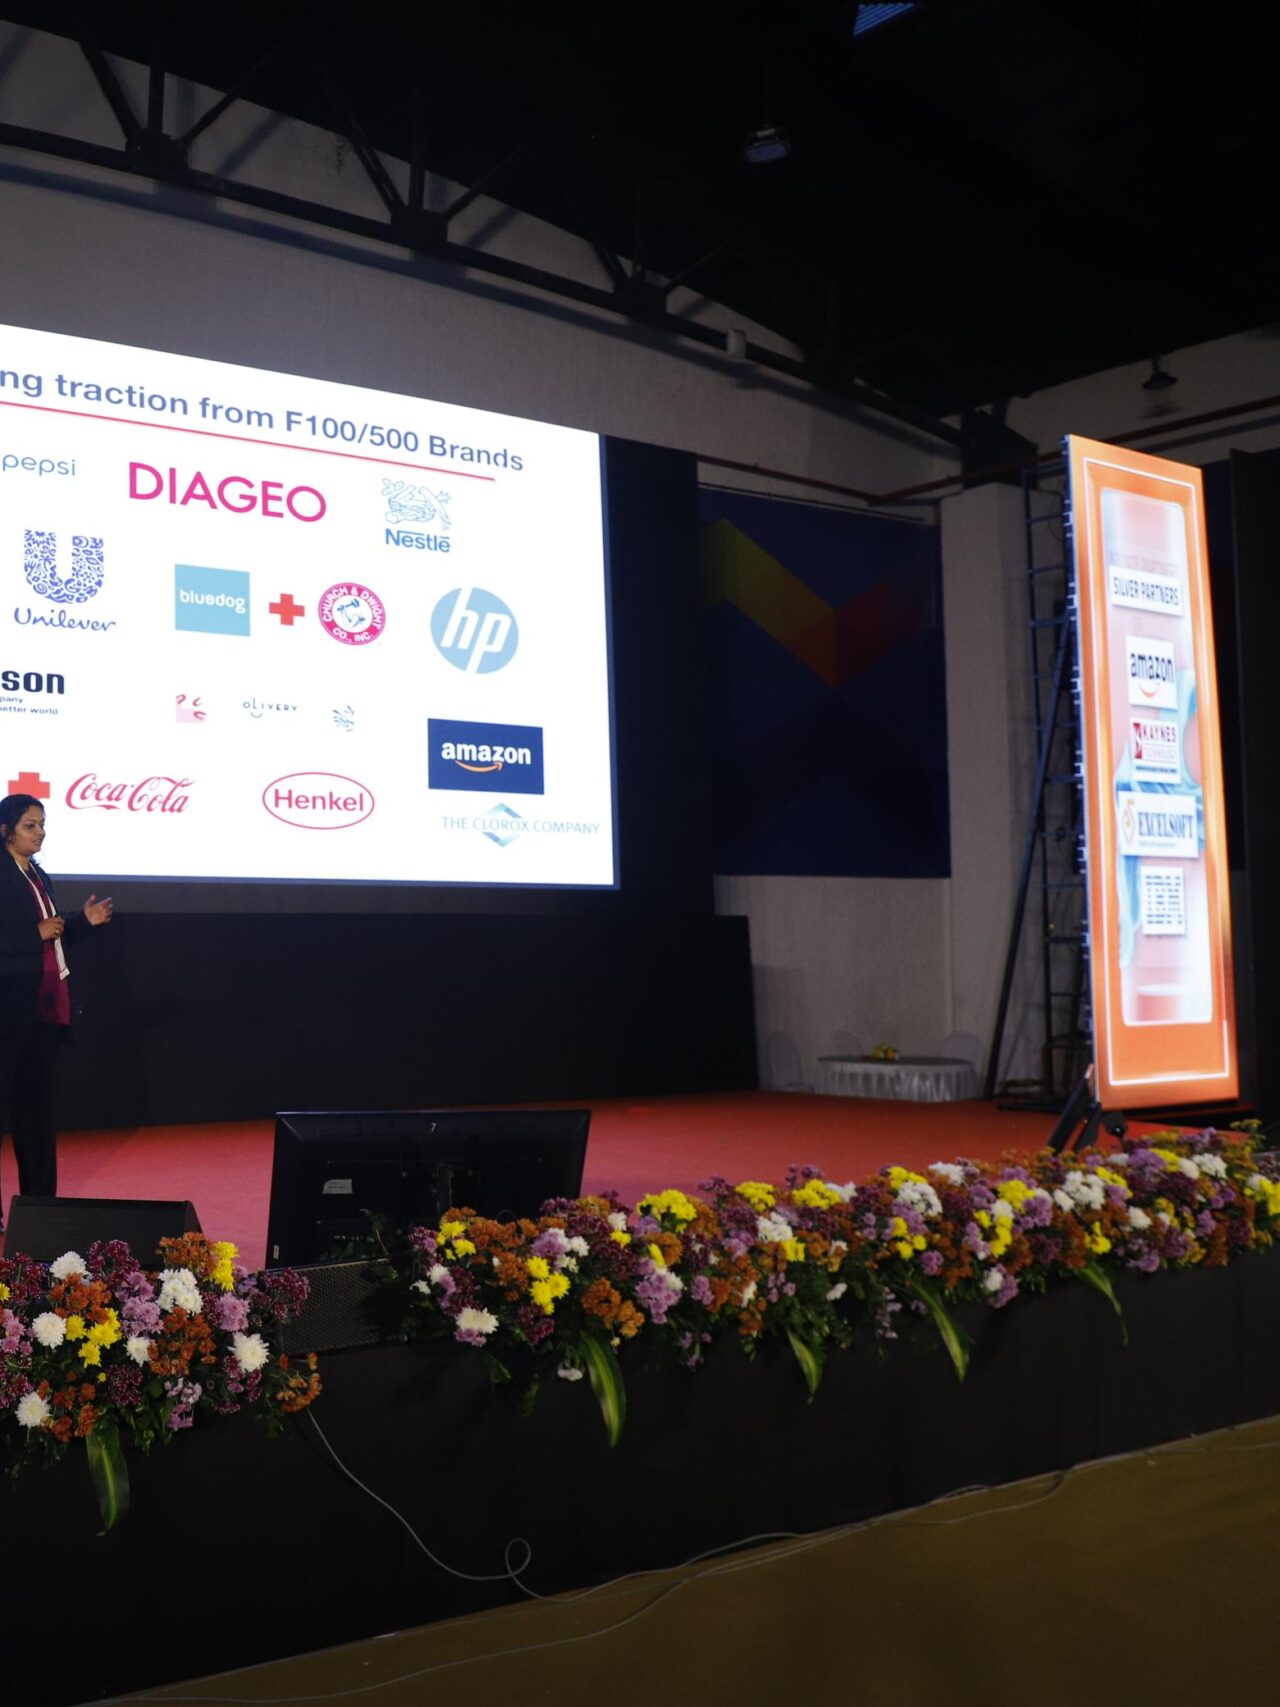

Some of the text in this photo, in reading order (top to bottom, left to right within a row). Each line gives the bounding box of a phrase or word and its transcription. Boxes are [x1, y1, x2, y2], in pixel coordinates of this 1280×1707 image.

[55, 374, 188, 415] traction
[199, 397, 274, 429] from
[286, 410, 419, 452] F100/500
[429, 435, 524, 471] Brands
[2, 453, 76, 476] pepsi
[128, 461, 327, 522] DIAGEO
[179, 589, 247, 614] bluedog
[1113, 576, 1179, 606] SILVER PARTNERS
[14, 607, 116, 632] Unilever
[321, 585, 349, 623] CHURCH
[360, 590, 384, 630] DWIGHT
[439, 586, 512, 674] hp
[1130, 652, 1174, 683] amazon
[30, 707, 58, 716] world
[441, 741, 532, 765] amazon
[65, 773, 196, 814] Coca-Cola
[274, 788, 364, 812] Henkel
[441, 816, 600, 835] THE CLOROX COMPANY
[1137, 811, 1194, 839] EXCELSOFT
